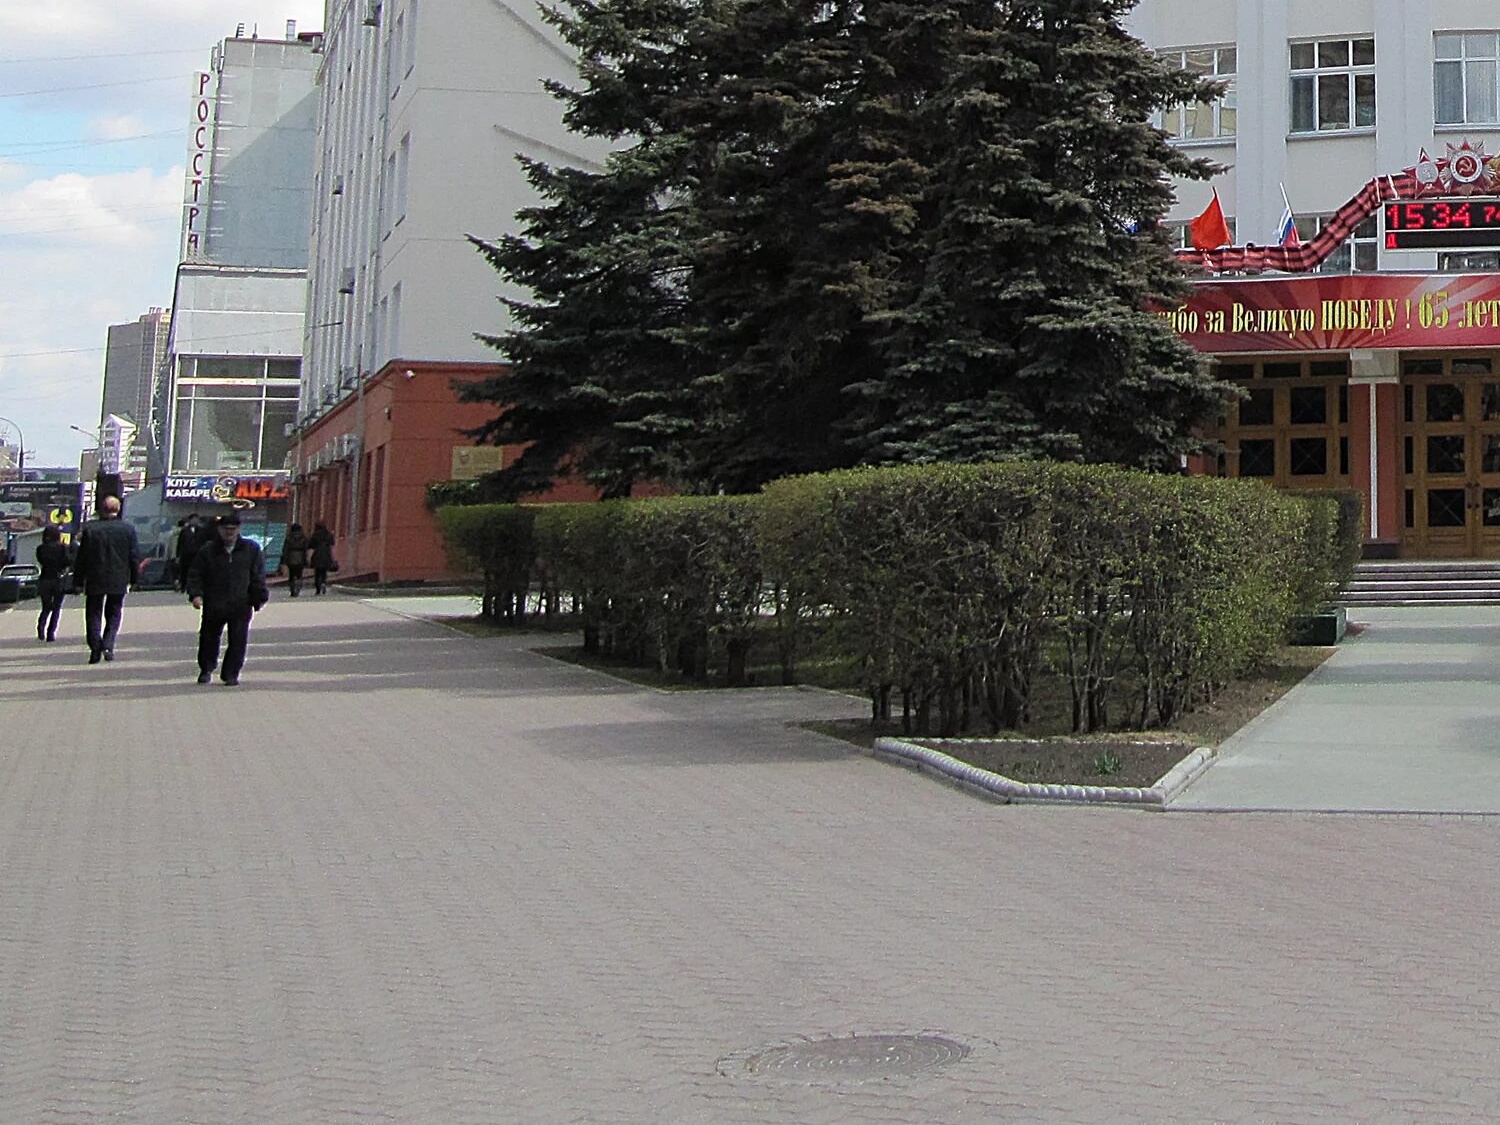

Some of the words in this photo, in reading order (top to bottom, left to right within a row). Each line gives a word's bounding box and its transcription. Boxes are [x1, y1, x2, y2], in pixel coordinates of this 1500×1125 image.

[1204, 309, 1226, 333] за
[1231, 301, 1316, 339] Великую
[1418, 291, 1449, 329] 65
[167, 477, 198, 488] КЛУБ
